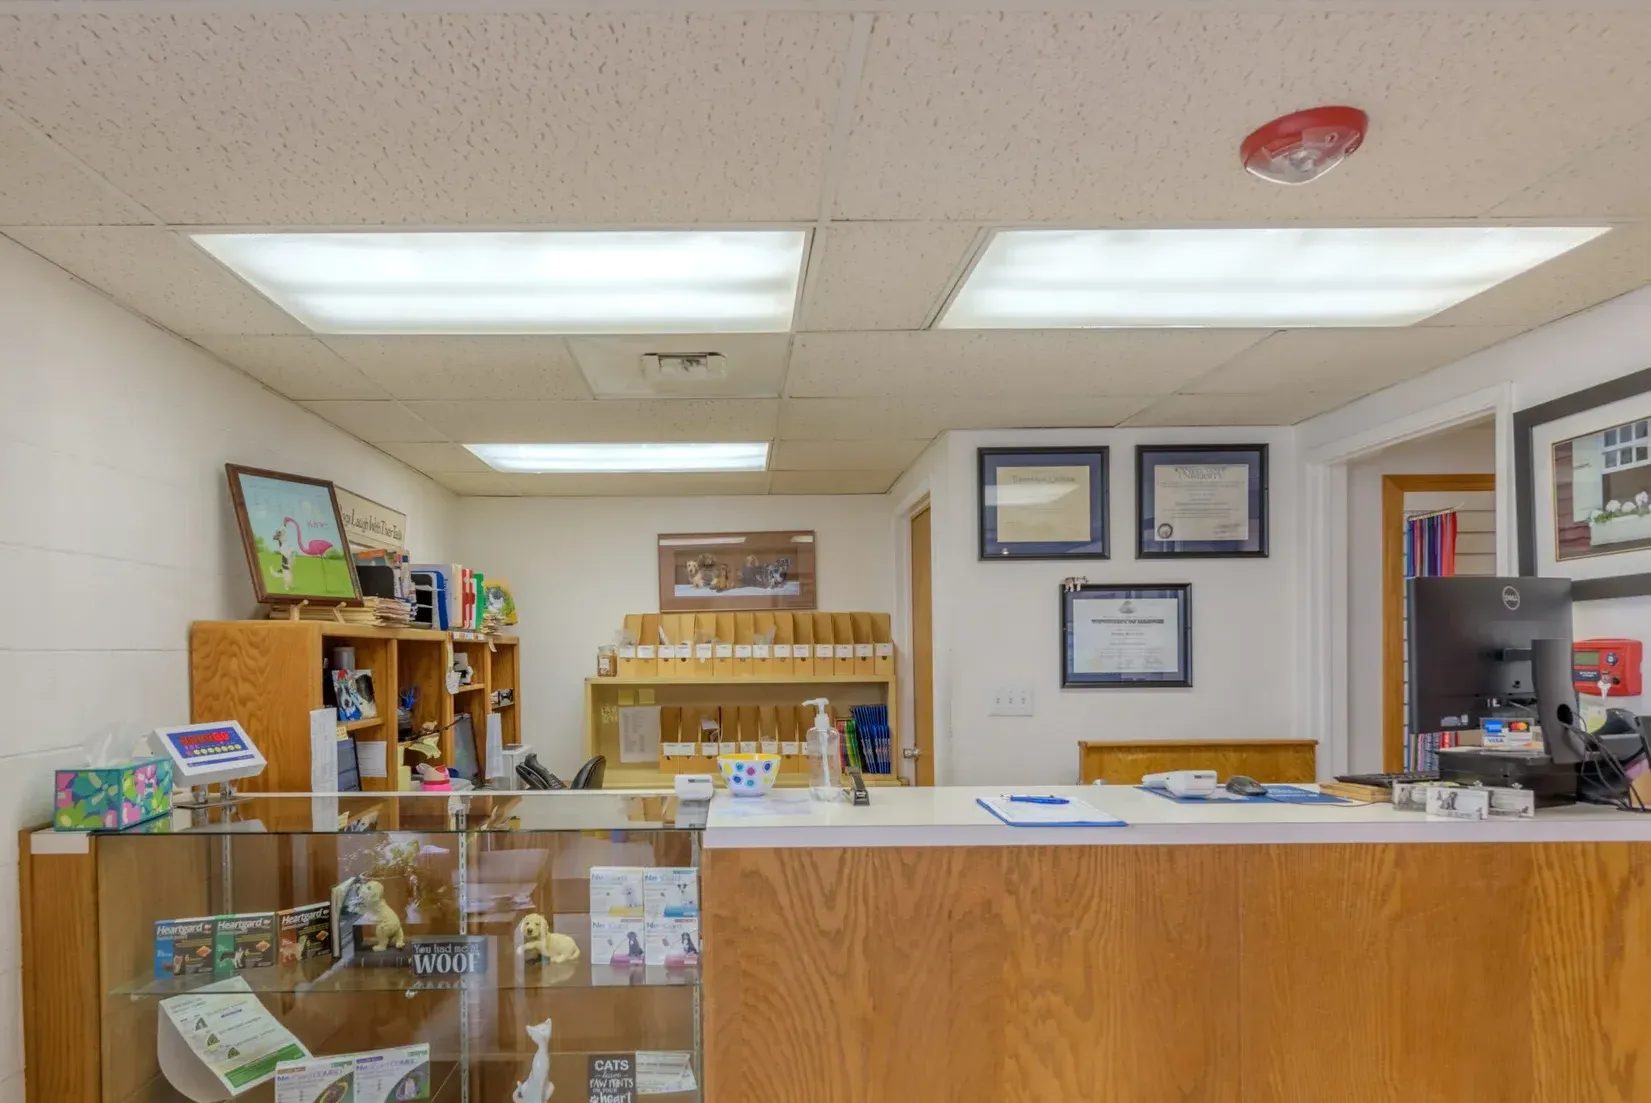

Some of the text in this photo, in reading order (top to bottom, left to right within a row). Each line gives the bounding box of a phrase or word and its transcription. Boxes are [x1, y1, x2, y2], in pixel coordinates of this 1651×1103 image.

[282, 908, 324, 925] Heartgard
[157, 923, 203, 936] Heartgard
[217, 918, 262, 932] Heartgard
[414, 943, 431, 953] You
[434, 943, 452, 953] had
[454, 945, 468, 953] me
[414, 953, 480, 973] WOOF
[595, 1060, 629, 1071] CATS
[600, 1091, 632, 1103] heart
